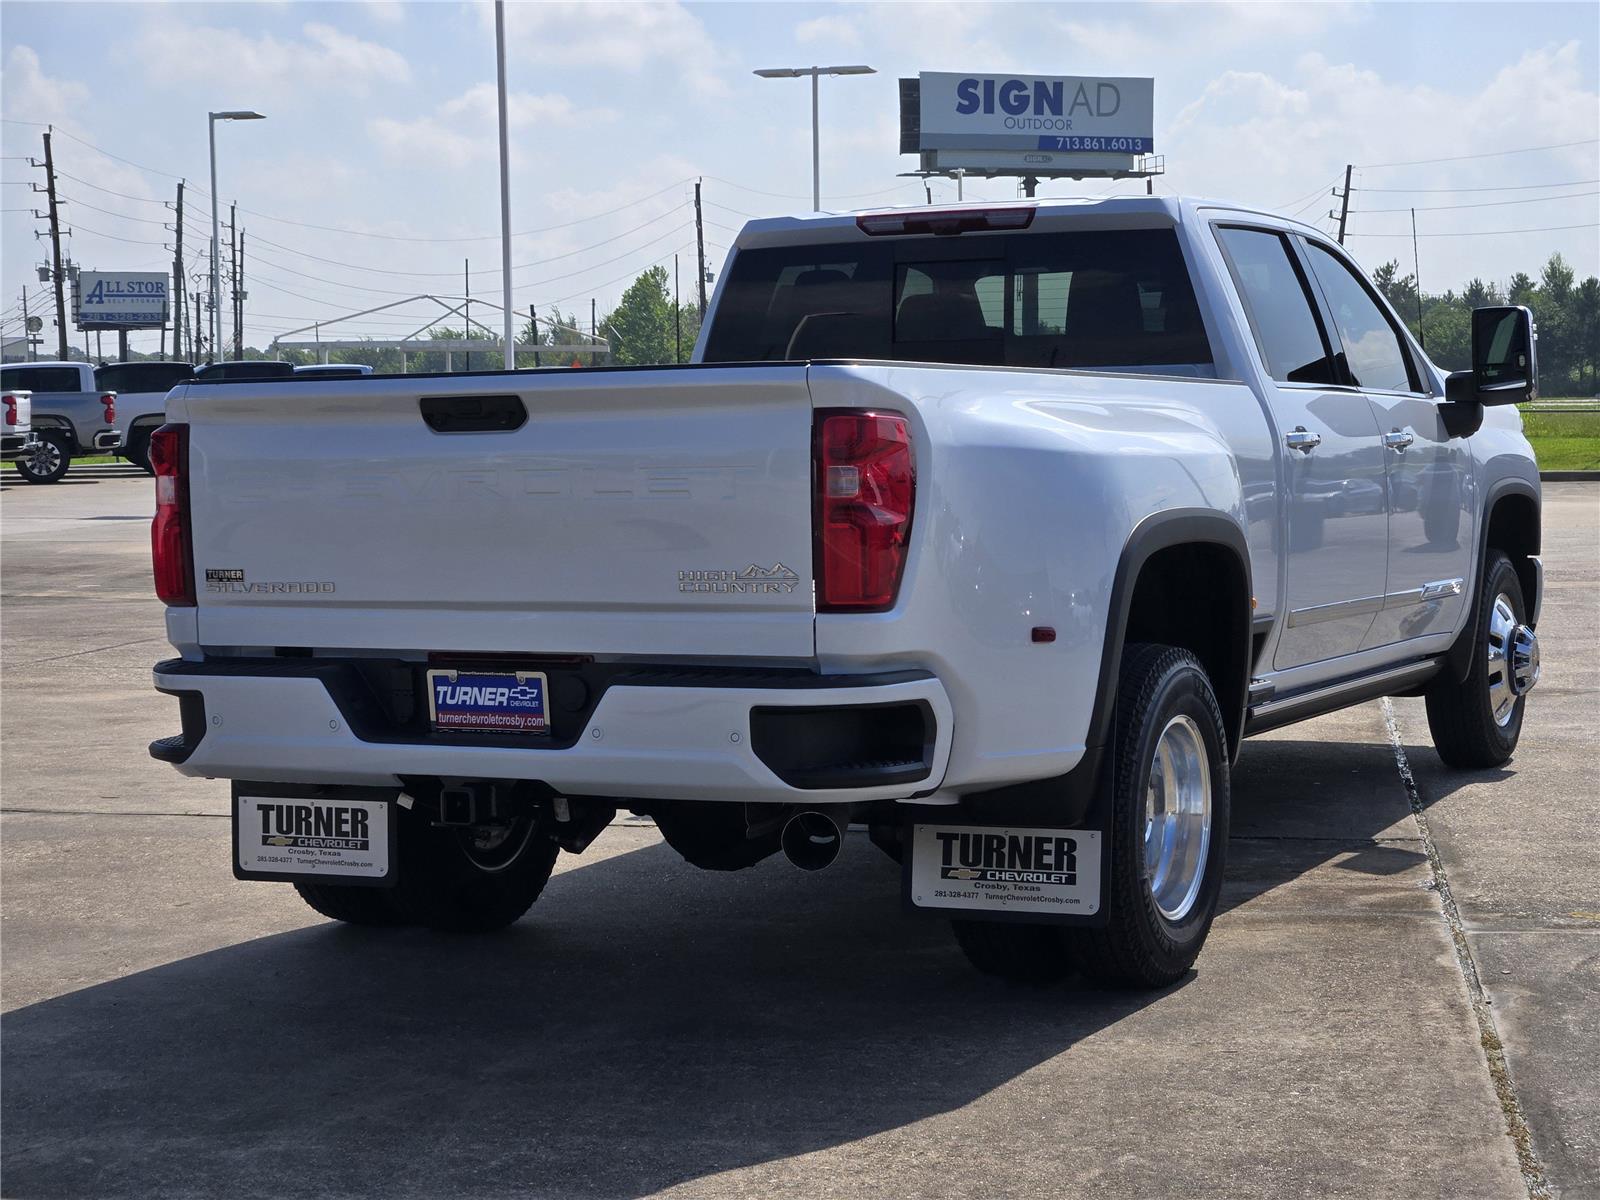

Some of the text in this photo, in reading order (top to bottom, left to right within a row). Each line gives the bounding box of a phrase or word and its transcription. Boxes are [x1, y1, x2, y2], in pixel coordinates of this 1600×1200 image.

[1004, 116, 1073, 131] OUTDOOR
[1056, 137, 1142, 150] 713.861.6013
[207, 570, 243, 579] TURNER
[678, 571, 738, 581] HIGH
[206, 581, 336, 593] SILVERADO
[678, 581, 799, 593] COUNTRY
[436, 686, 509, 706] TURNER
[510, 700, 539, 708] CHEVROLET
[438, 712, 544, 728] turnerchevroletcrosby.com
[256, 804, 369, 838] TURNER
[297, 838, 363, 849] CHEVROLET
[288, 848, 342, 857] Crosby, Texas
[936, 832, 1077, 872] TURNER
[986, 871, 1068, 884] CHEVROLET
[974, 881, 1041, 892] Crosby, Texas
[934, 890, 1081, 905] 281-328-4377 TurnerChevroletCrosby.com
